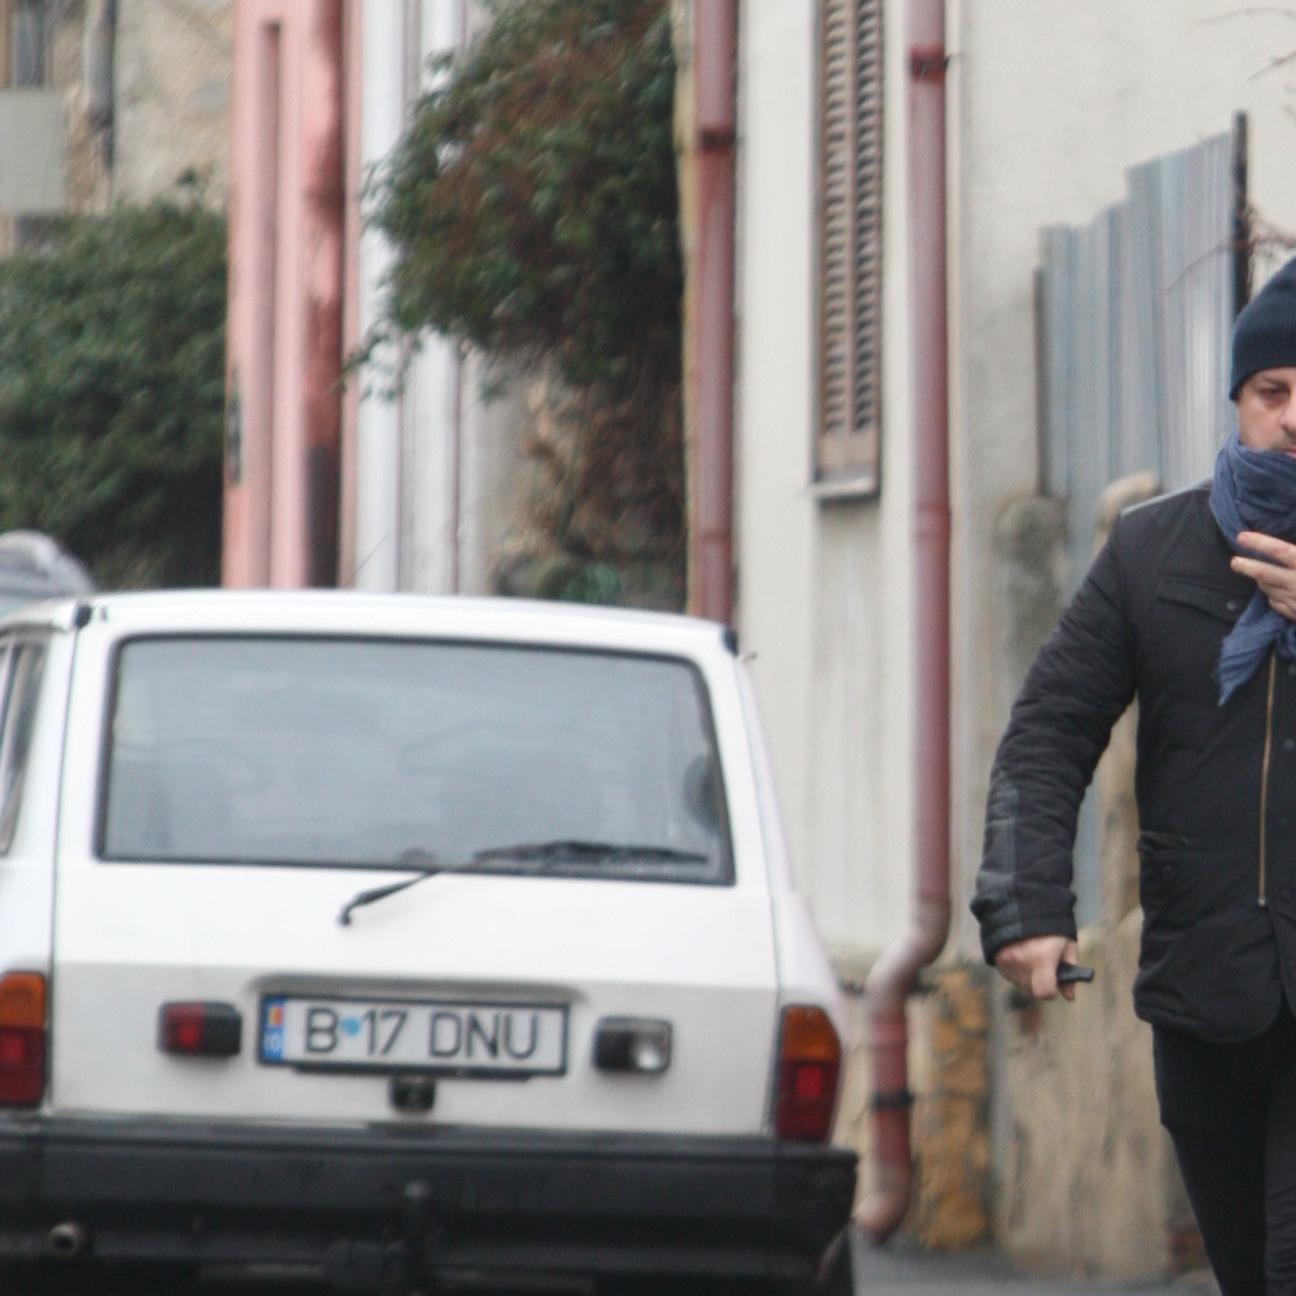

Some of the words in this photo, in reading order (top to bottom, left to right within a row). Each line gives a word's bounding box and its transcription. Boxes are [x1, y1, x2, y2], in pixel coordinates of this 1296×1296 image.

[306, 1007, 339, 1053] B
[362, 1010, 408, 1056] 17
[430, 1012, 538, 1059] DNU
